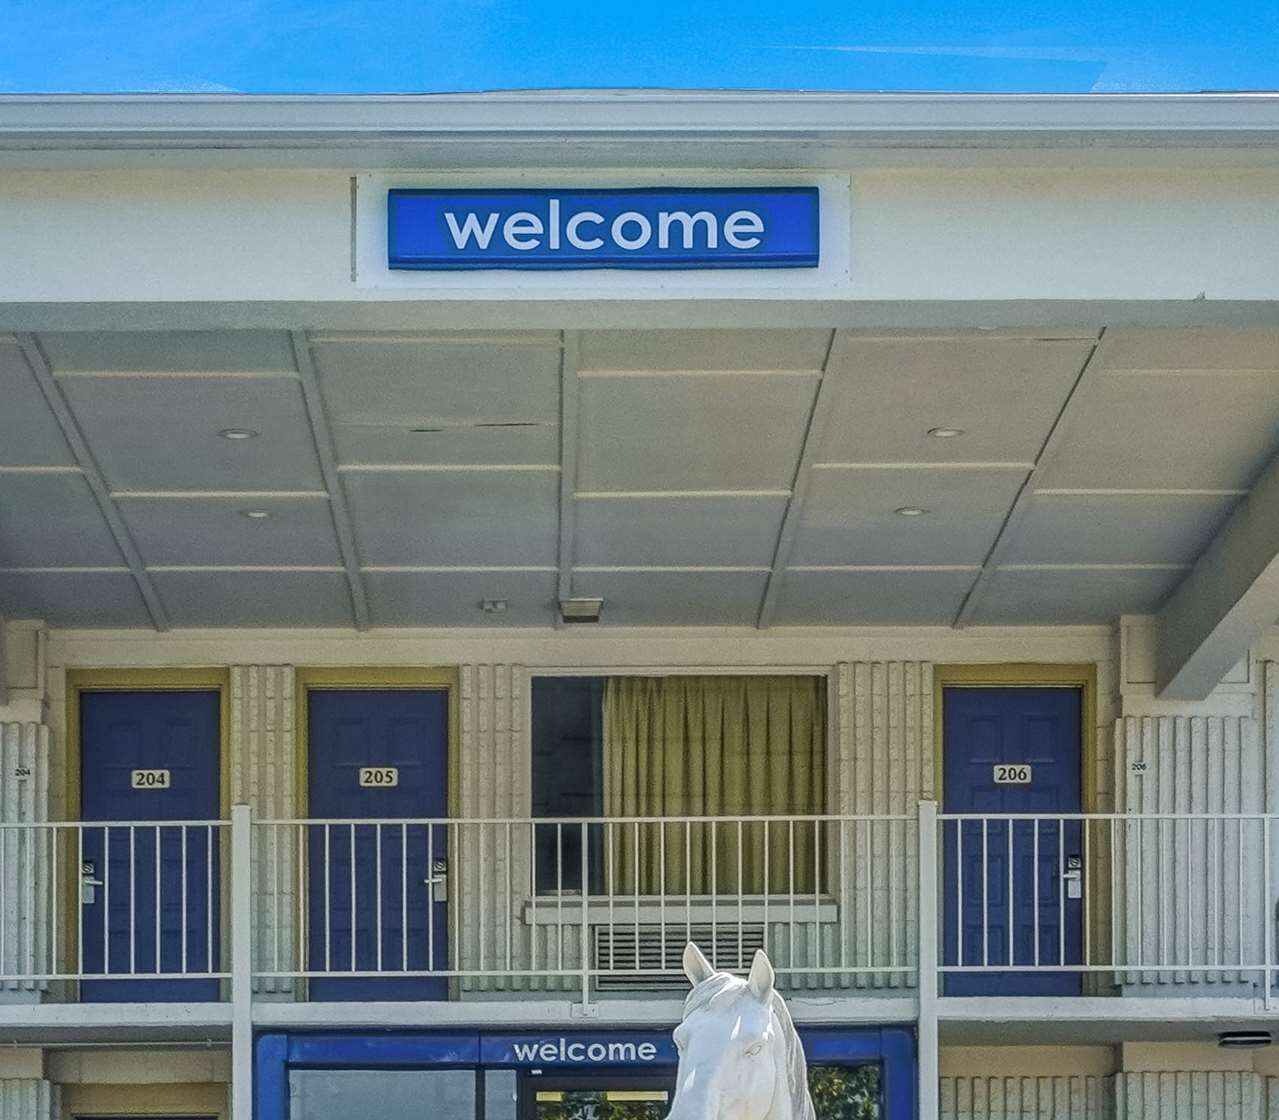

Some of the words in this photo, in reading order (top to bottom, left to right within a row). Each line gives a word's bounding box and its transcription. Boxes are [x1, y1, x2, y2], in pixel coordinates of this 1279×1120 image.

[445, 198, 765, 251] welcome
[135, 772, 166, 786] 204
[363, 770, 394, 784] 205
[998, 767, 1028, 781] 206
[513, 1038, 657, 1063] welcome
